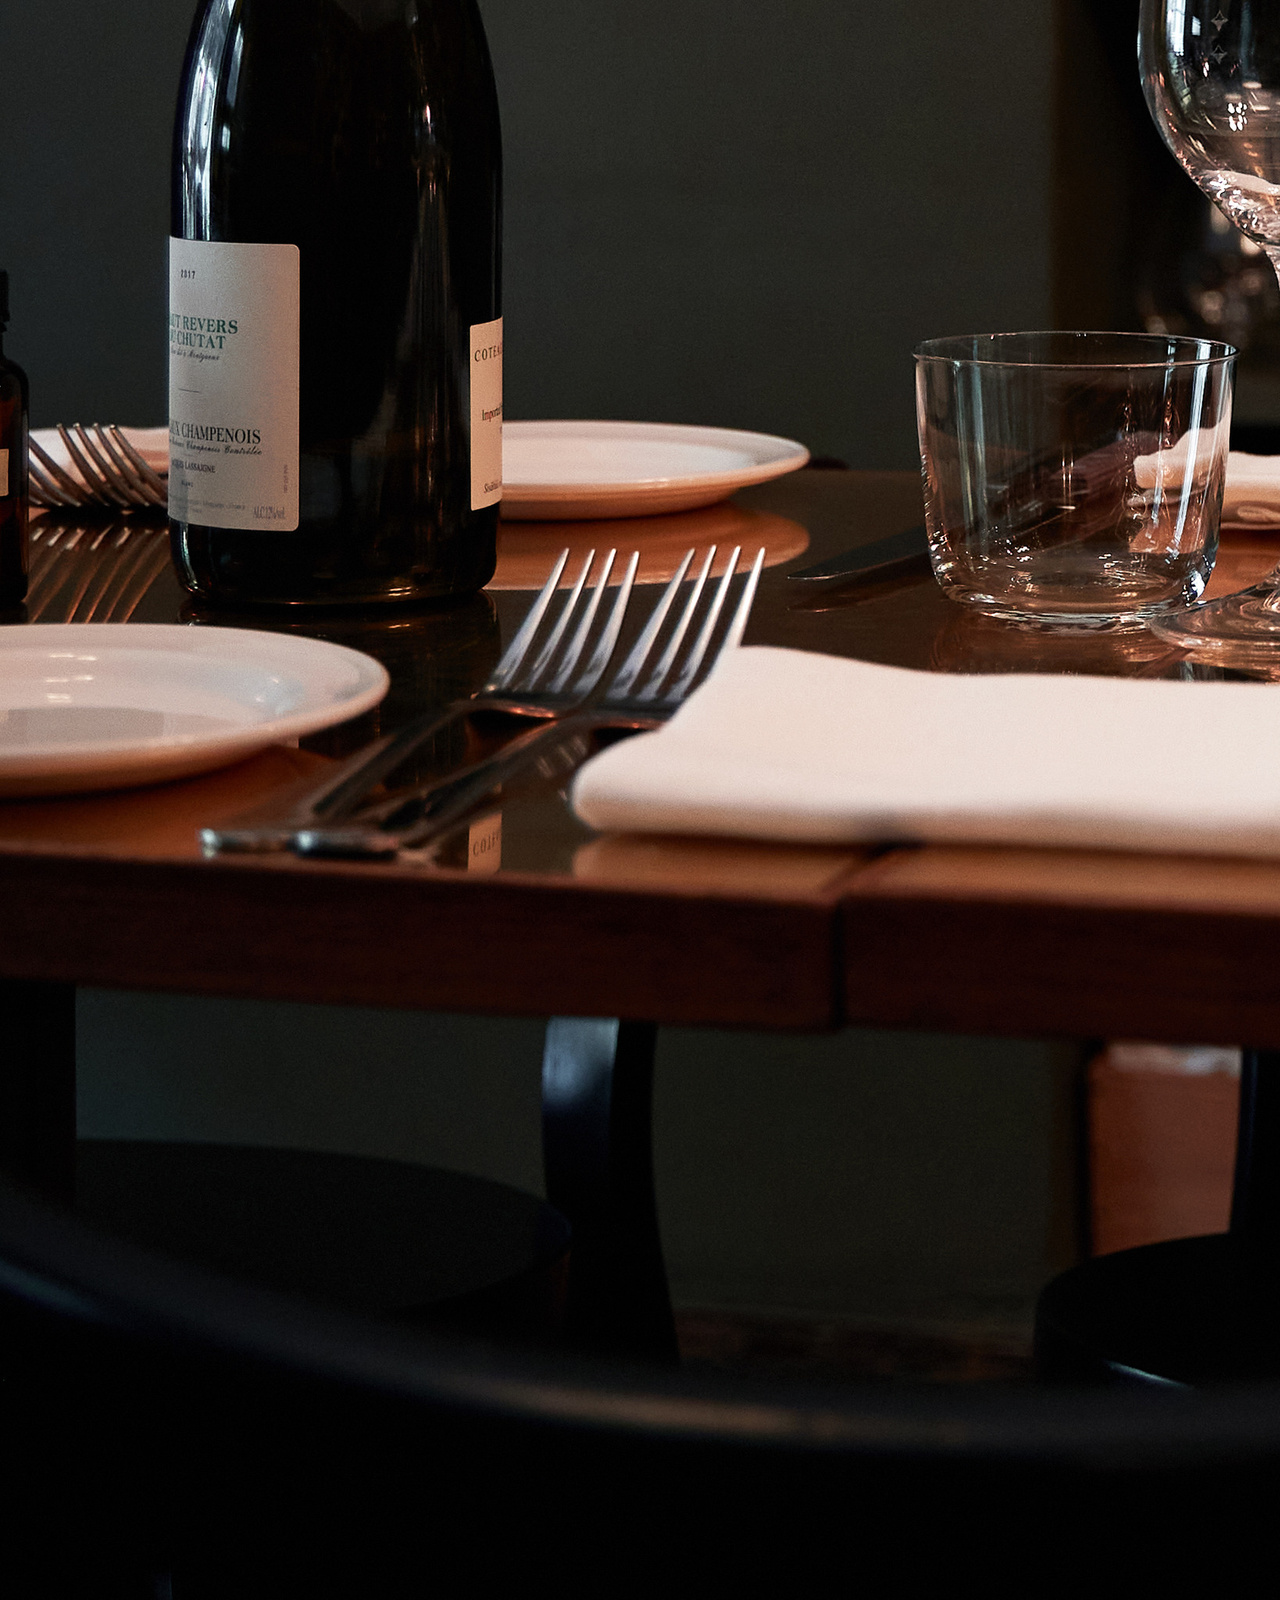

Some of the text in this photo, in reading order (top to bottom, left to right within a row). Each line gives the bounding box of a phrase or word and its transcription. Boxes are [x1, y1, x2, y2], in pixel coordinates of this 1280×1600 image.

[180, 268, 196, 280] 2017
[183, 317, 238, 335] REVERS
[177, 331, 226, 349] CHUTAT
[181, 422, 262, 445] CHAMPENOIS
[185, 461, 216, 474] LASSAIGNE
